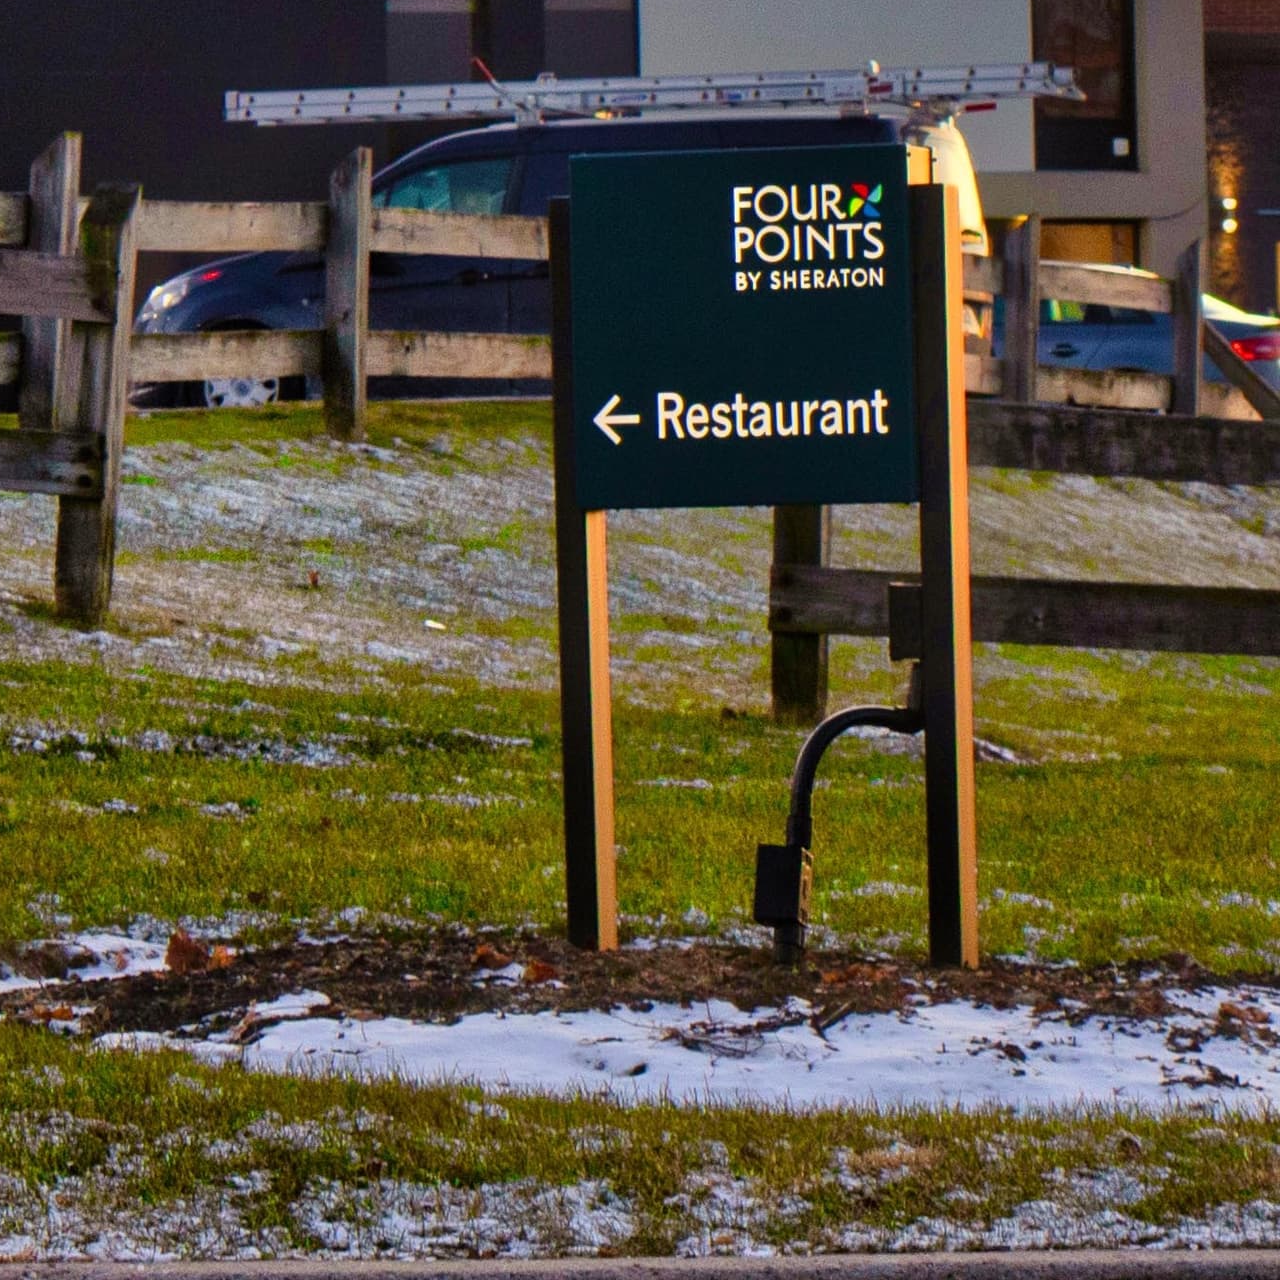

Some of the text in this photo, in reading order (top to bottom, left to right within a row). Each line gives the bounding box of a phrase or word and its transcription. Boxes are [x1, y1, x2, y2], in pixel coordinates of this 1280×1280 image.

[732, 183, 847, 224] FOUR
[734, 221, 885, 264] POINTS
[735, 266, 885, 292] BY SHERATON
[656, 388, 889, 440] Restaurant
